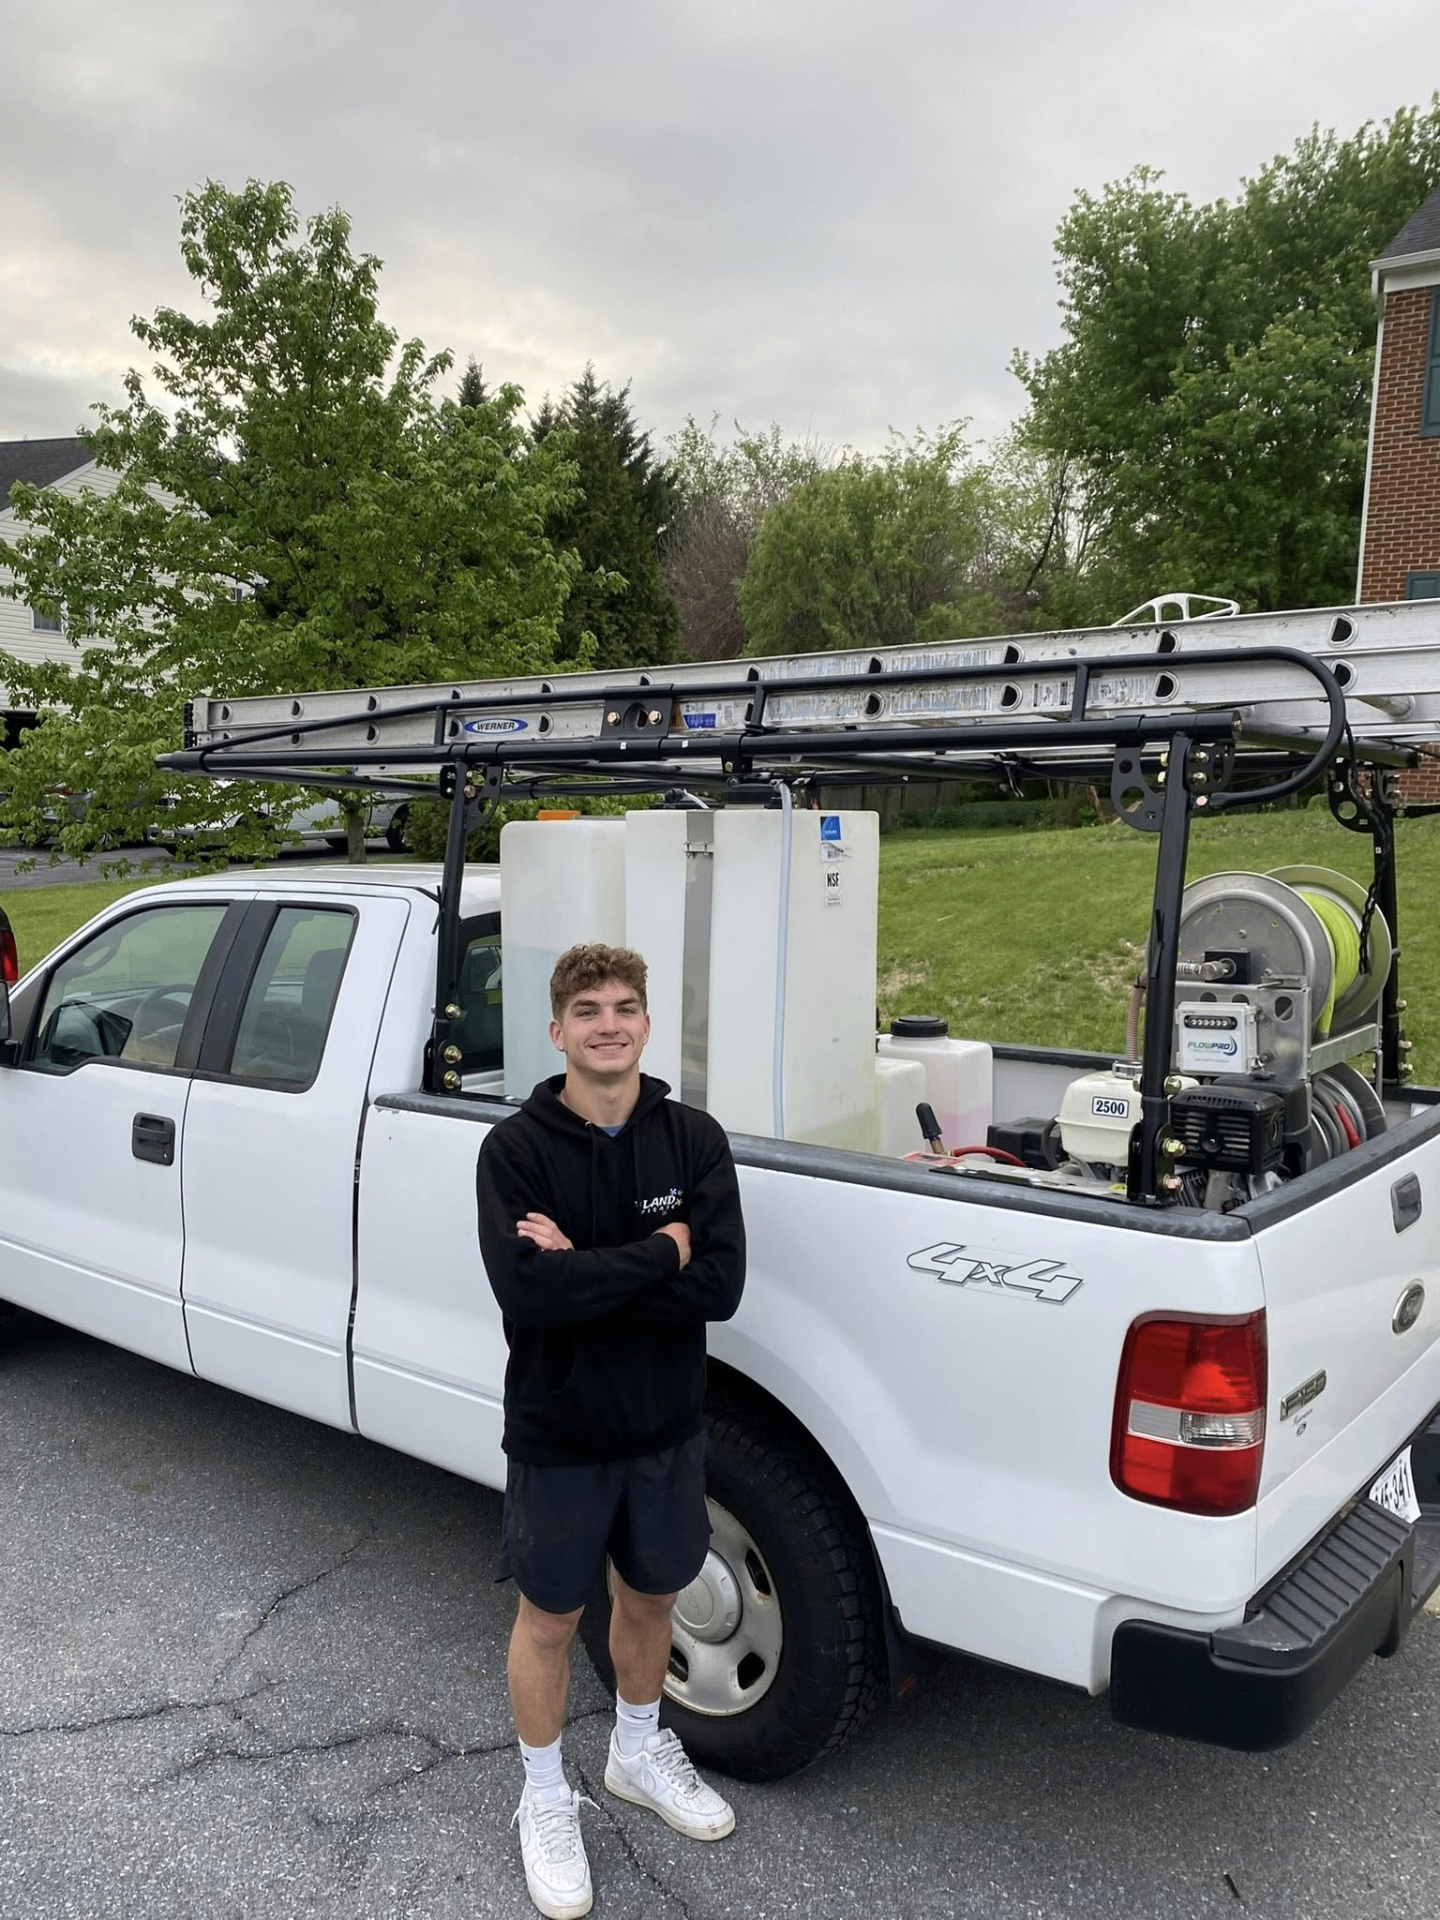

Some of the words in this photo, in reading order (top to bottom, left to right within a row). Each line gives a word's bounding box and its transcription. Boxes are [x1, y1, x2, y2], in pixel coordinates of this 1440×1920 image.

[477, 721, 515, 730] WERNER
[827, 873, 839, 887] NSF
[1187, 1041, 1230, 1050] FLOWPRO
[1095, 1099, 1125, 1115] 2500
[643, 1195, 676, 1209] LAND
[906, 1242, 1084, 1304] 4x4
